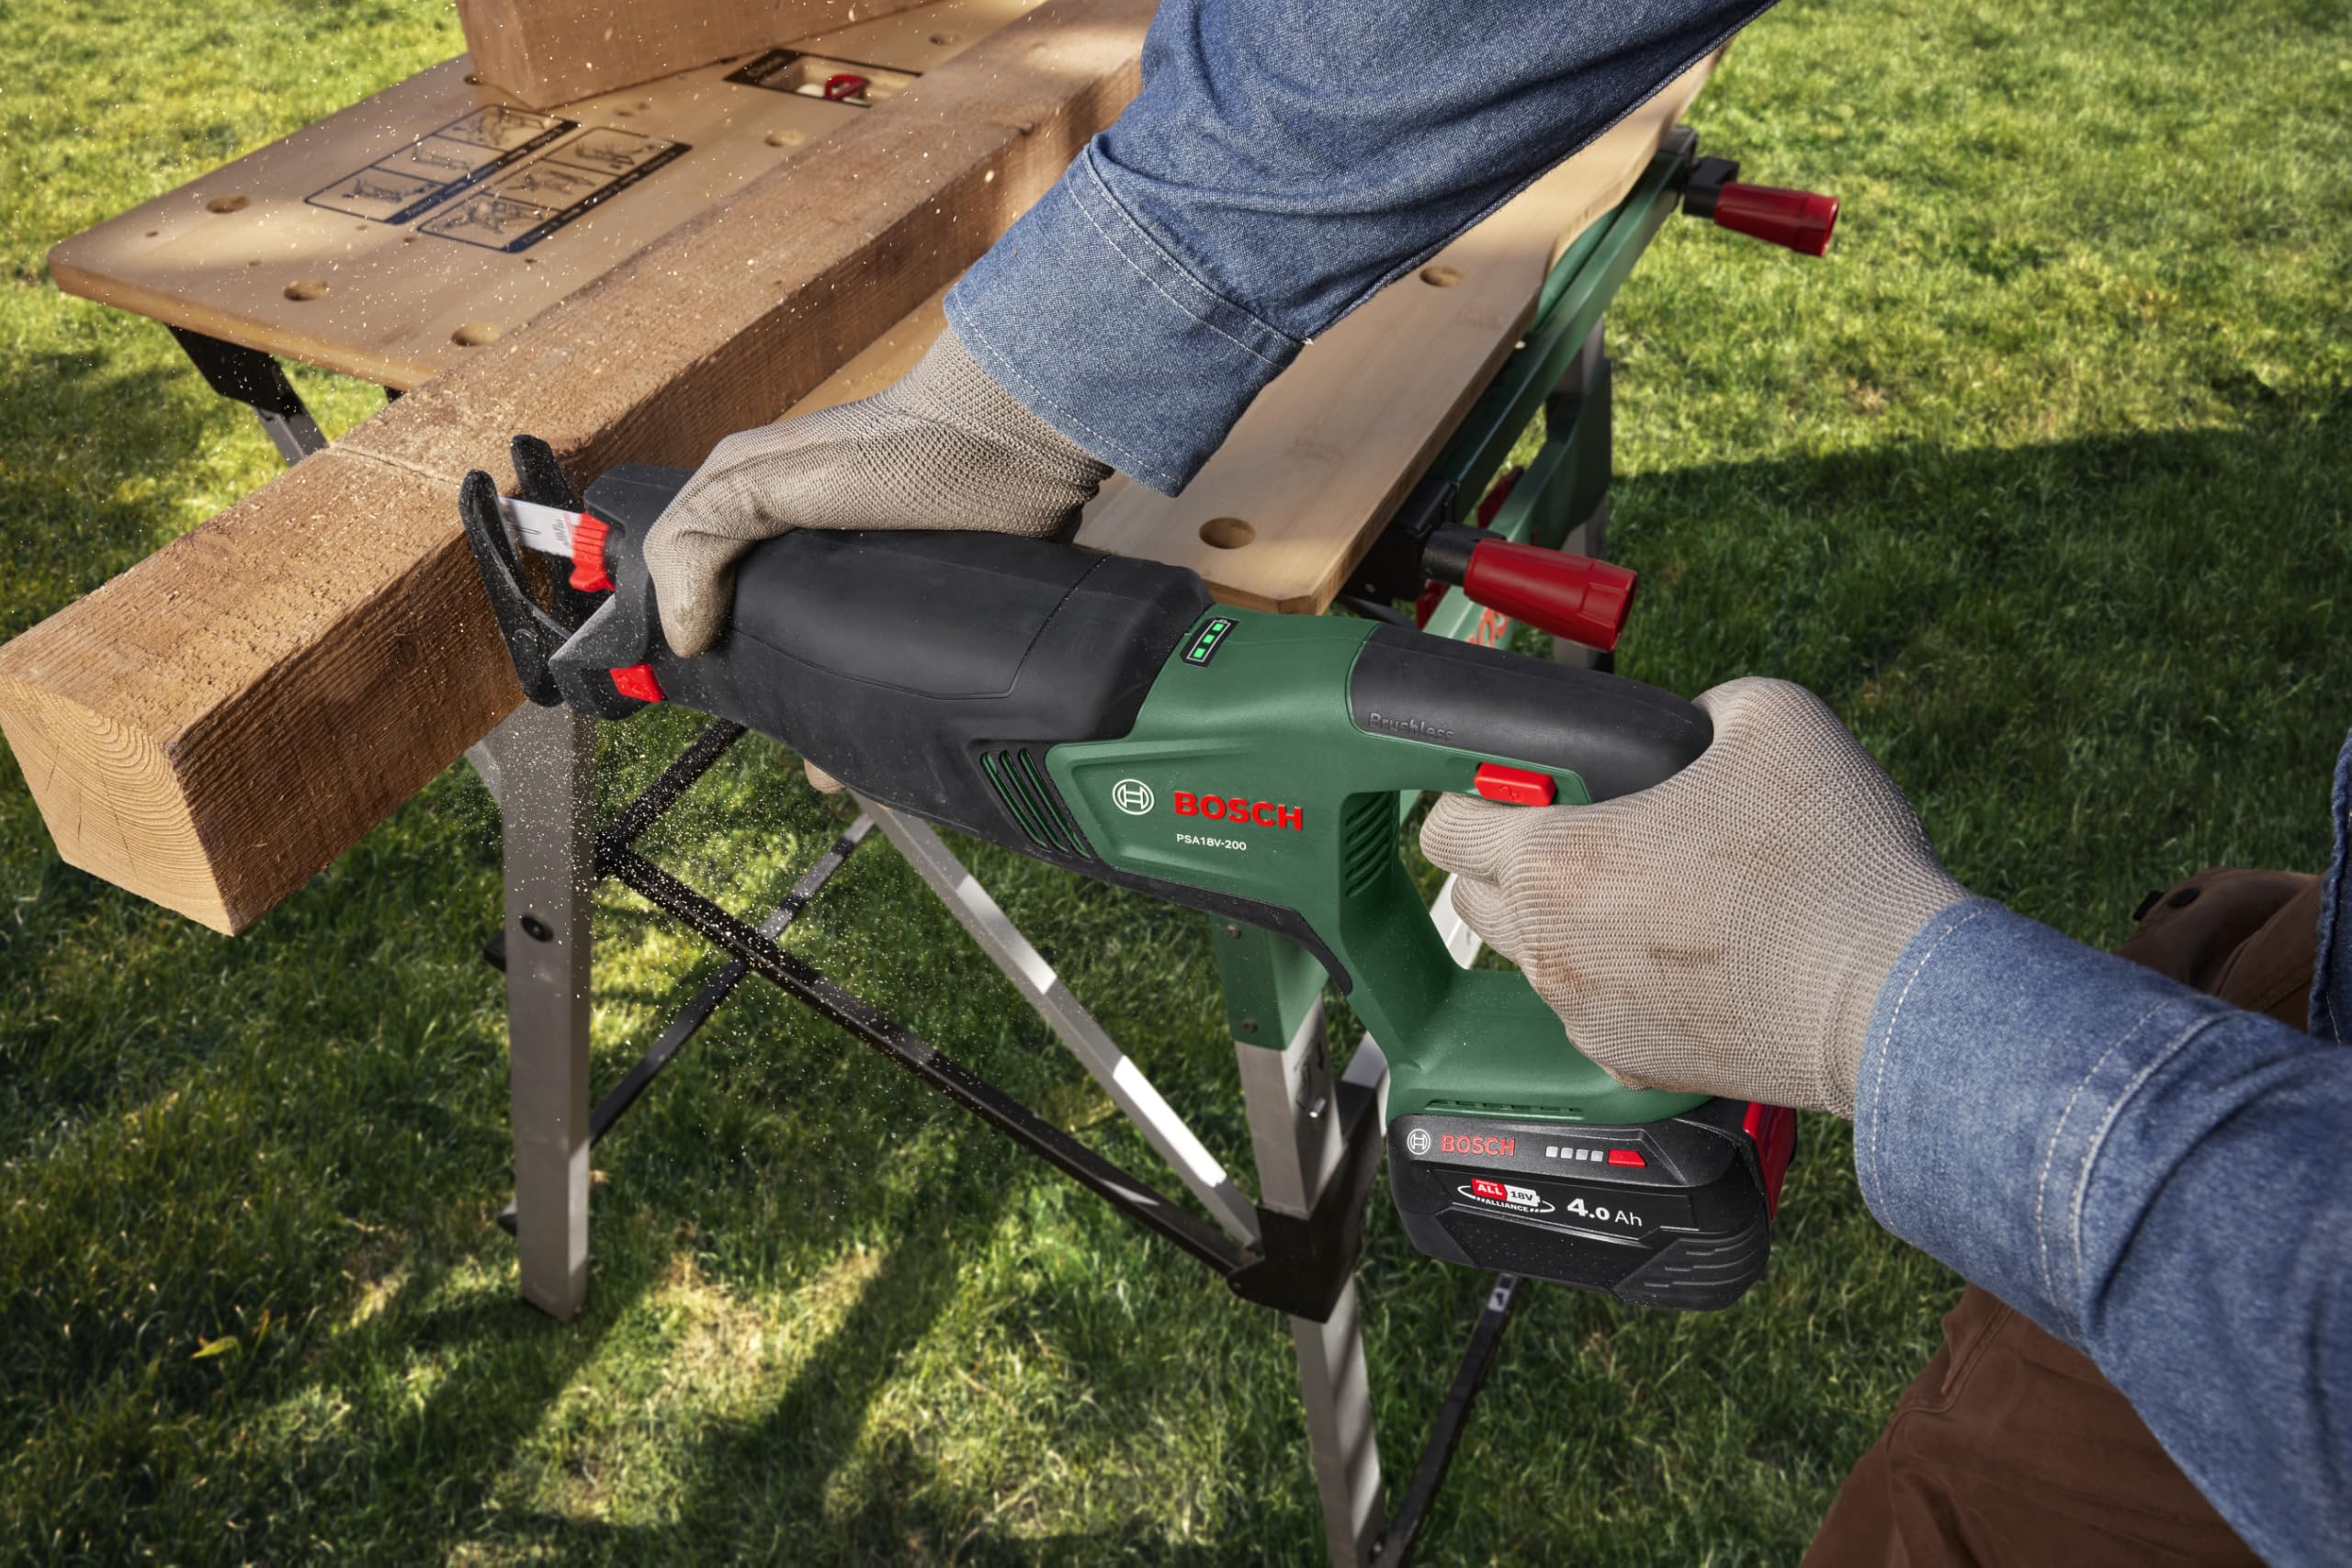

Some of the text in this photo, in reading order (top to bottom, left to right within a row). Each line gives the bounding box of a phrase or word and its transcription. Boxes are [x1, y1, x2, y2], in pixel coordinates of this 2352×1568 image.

[1369, 712, 1455, 740] Brushless
[1174, 790, 1304, 831] BOSCH
[1176, 833, 1248, 852] PSA18V-200
[1441, 1134, 1516, 1157] BOSCH
[1477, 1184, 1503, 1196] ALL
[1510, 1190, 1533, 1201] 18V
[1485, 1198, 1530, 1213] ALLIANCE
[1566, 1198, 1643, 1227] 4.0 Ah
